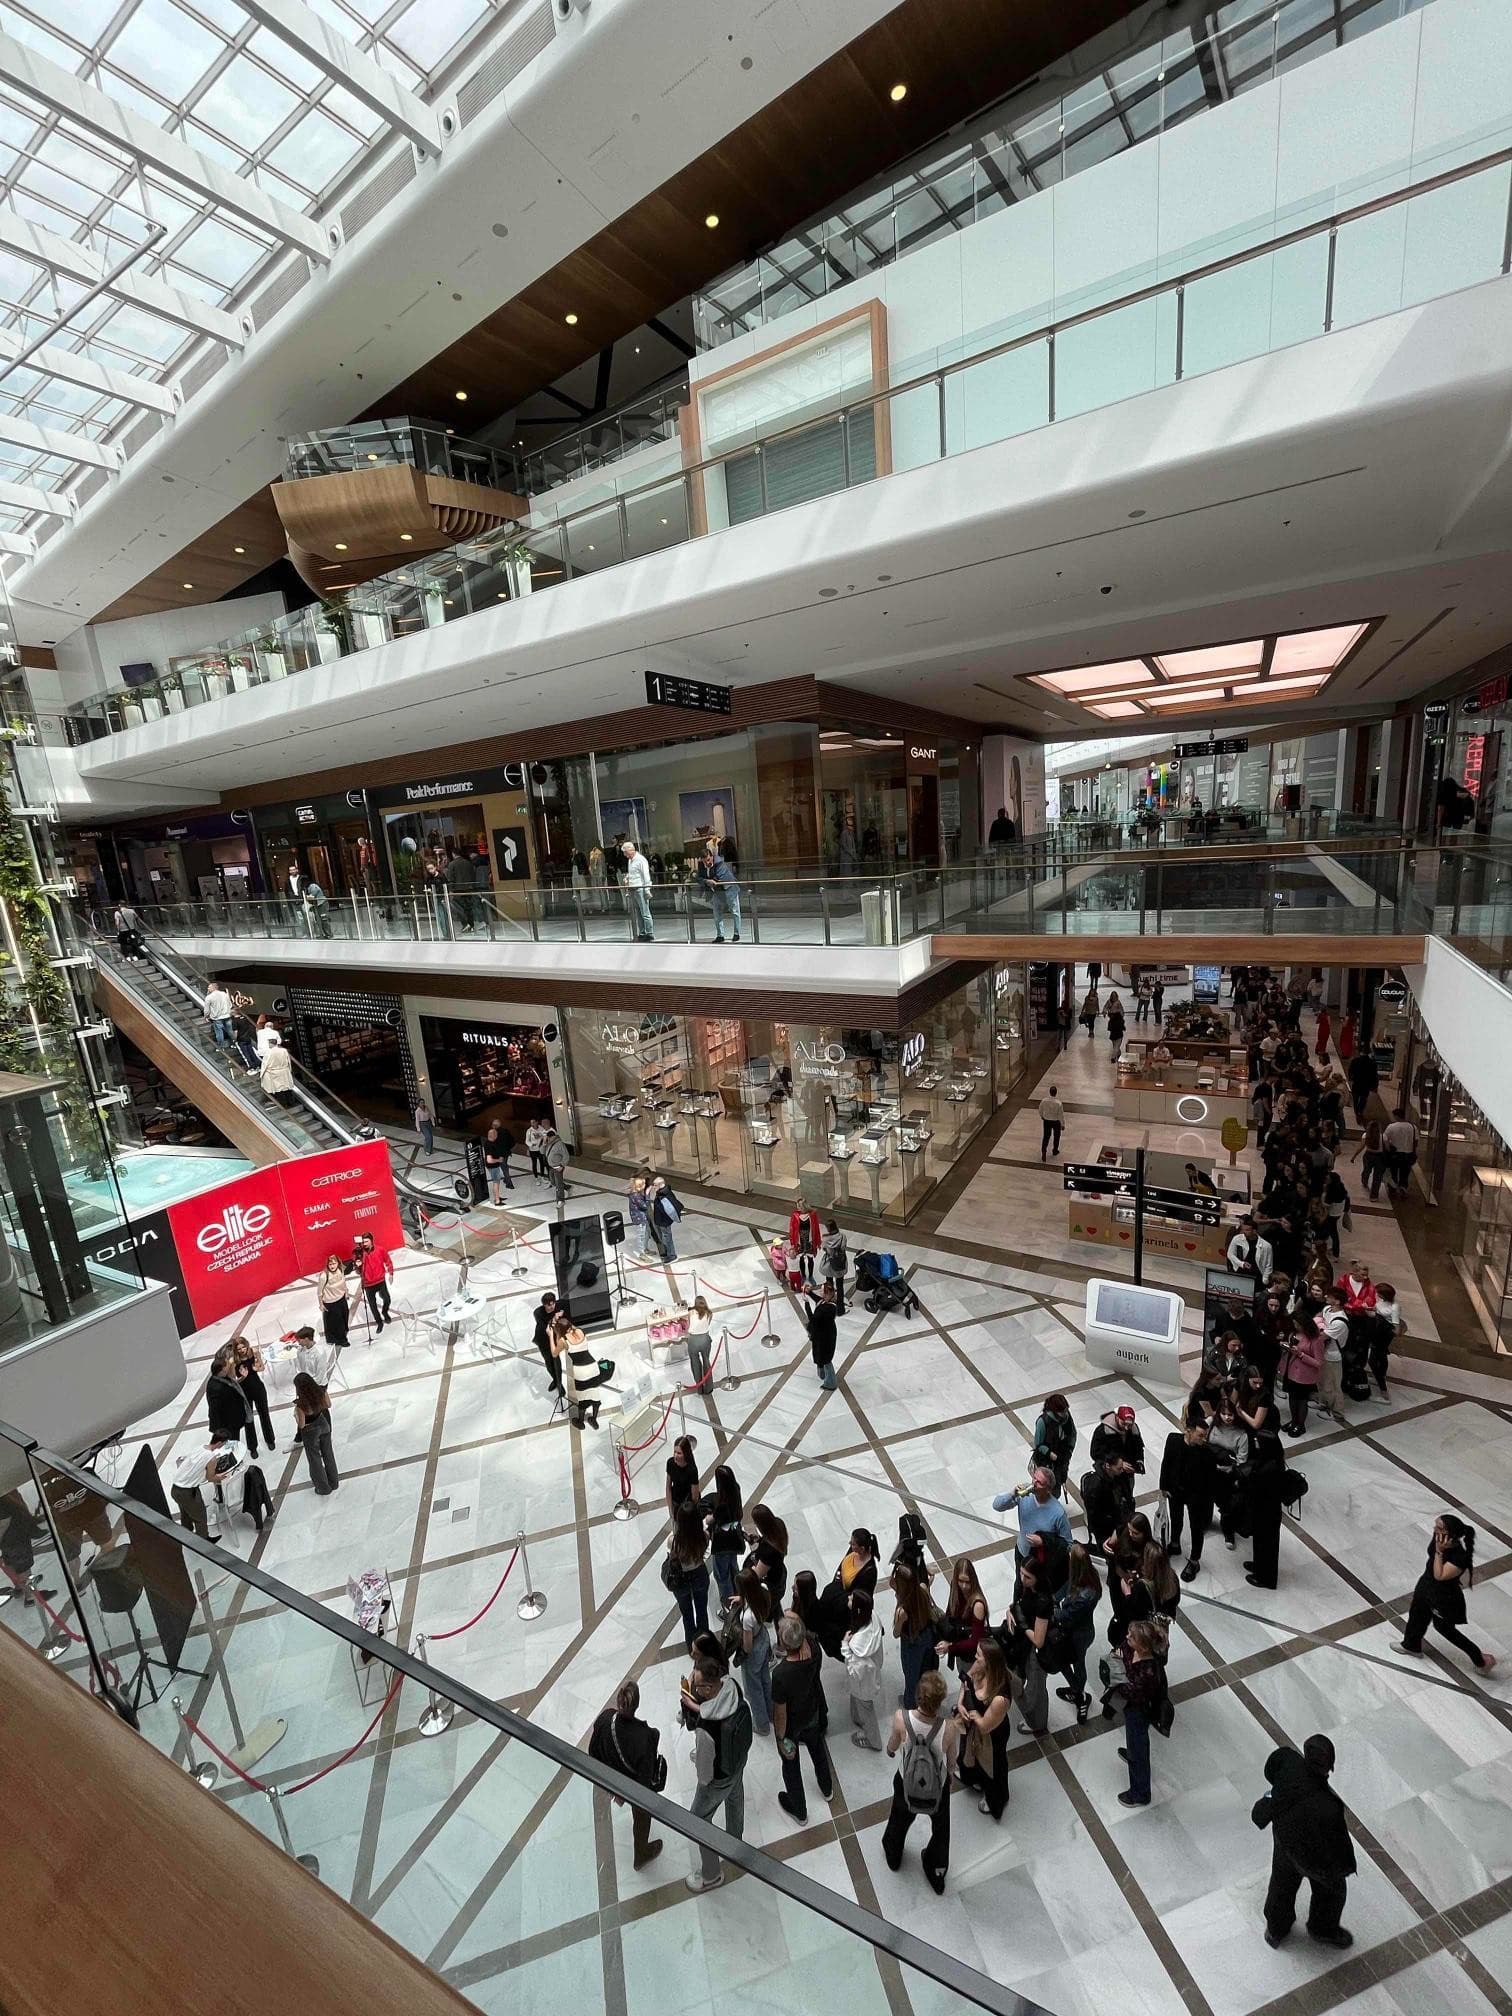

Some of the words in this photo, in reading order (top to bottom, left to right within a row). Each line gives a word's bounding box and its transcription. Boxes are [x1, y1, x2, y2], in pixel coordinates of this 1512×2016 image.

[652, 677, 661, 700] 1
[910, 746, 937, 760] GANT
[1464, 736, 1485, 798] REPLAY
[1138, 974, 1158, 984] ushi
[462, 1032, 508, 1047] RITUALS
[795, 1040, 846, 1064] ALO
[800, 1061, 839, 1077] diamonds
[196, 1203, 271, 1252] elite
[213, 1243, 241, 1261] MODEL
[242, 1233, 264, 1248] LOOK
[1143, 1236, 1179, 1250] arinela
[207, 1254, 235, 1272] CZECH
[235, 1237, 273, 1259] REPUBLIC
[224, 1250, 262, 1272] SLOVAKIA
[1207, 1284, 1241, 1295] CASTING
[1115, 1349, 1150, 1364] aupark
